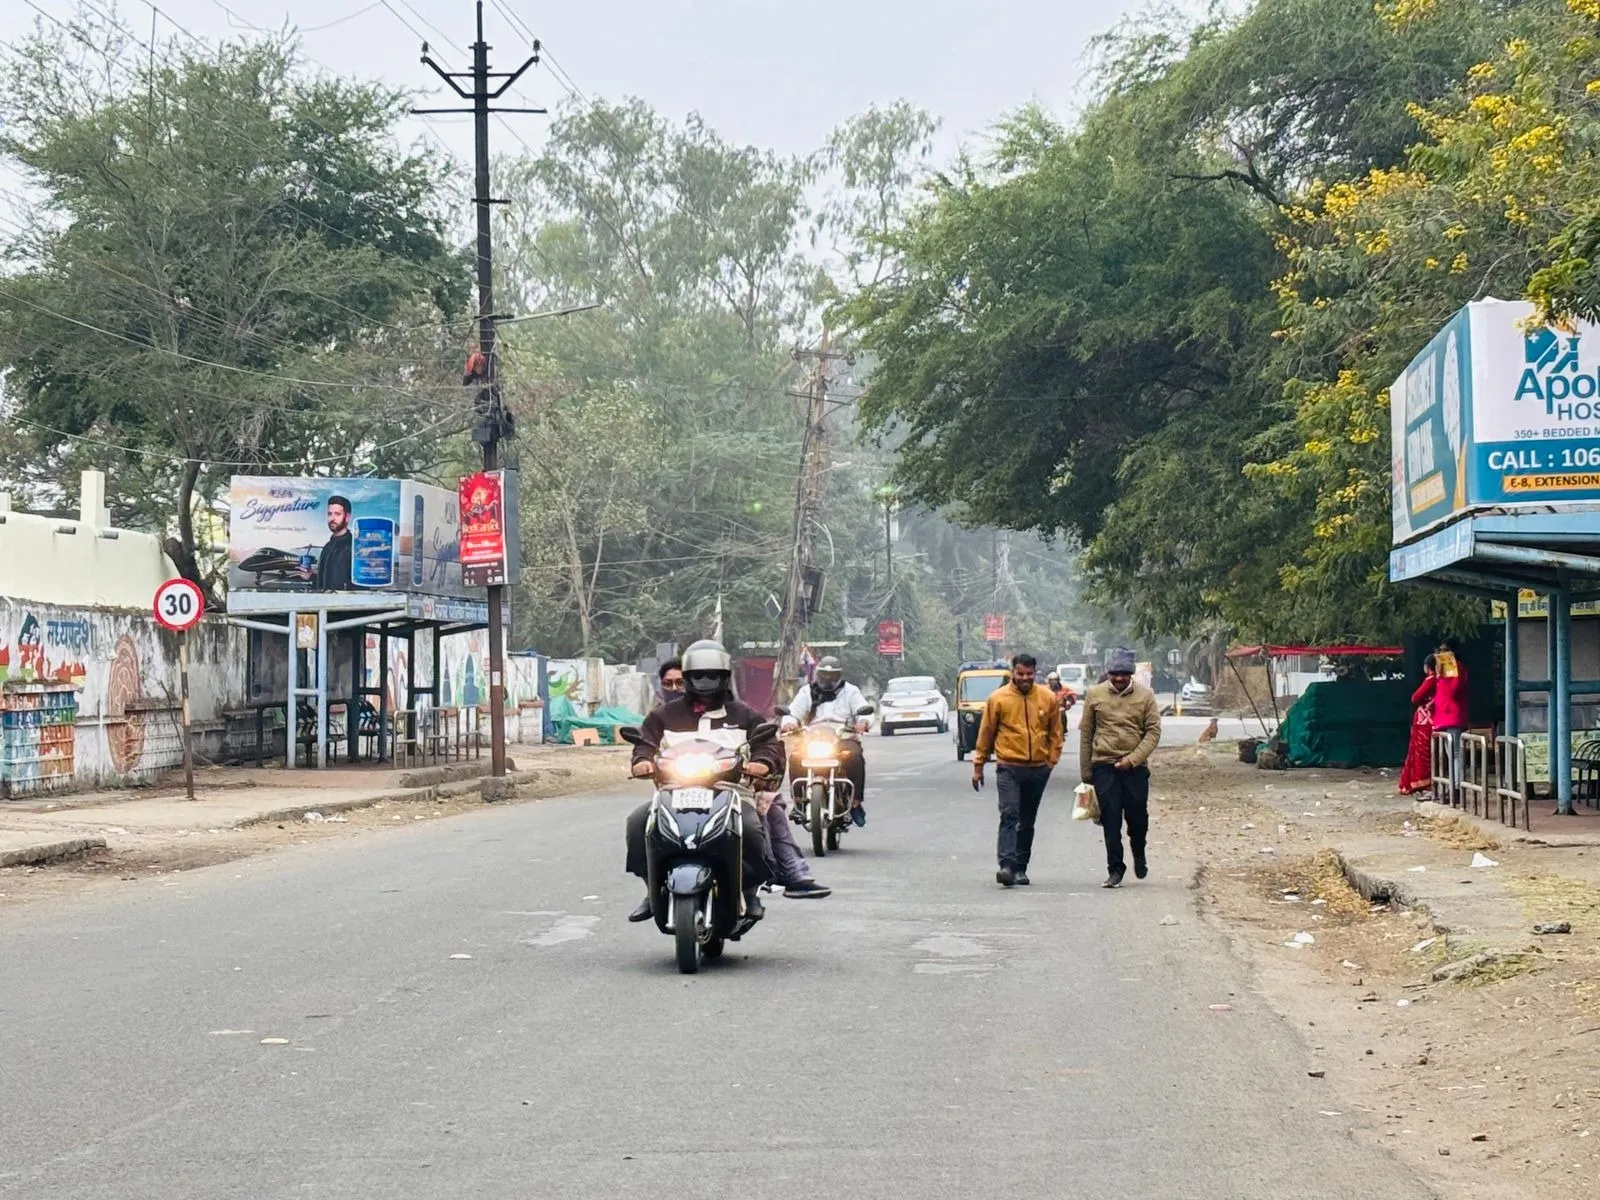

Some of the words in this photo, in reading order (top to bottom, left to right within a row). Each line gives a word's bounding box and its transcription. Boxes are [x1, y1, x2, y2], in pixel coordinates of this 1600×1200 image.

[1514, 429, 1539, 439] 350+
[1543, 427, 1591, 438] BEDDED
[1488, 450, 1542, 470] CALL
[1561, 448, 1600, 468] 106
[1510, 478, 1532, 489] E-8,
[1535, 475, 1599, 487] EXTENSION
[164, 593, 192, 617] 30
